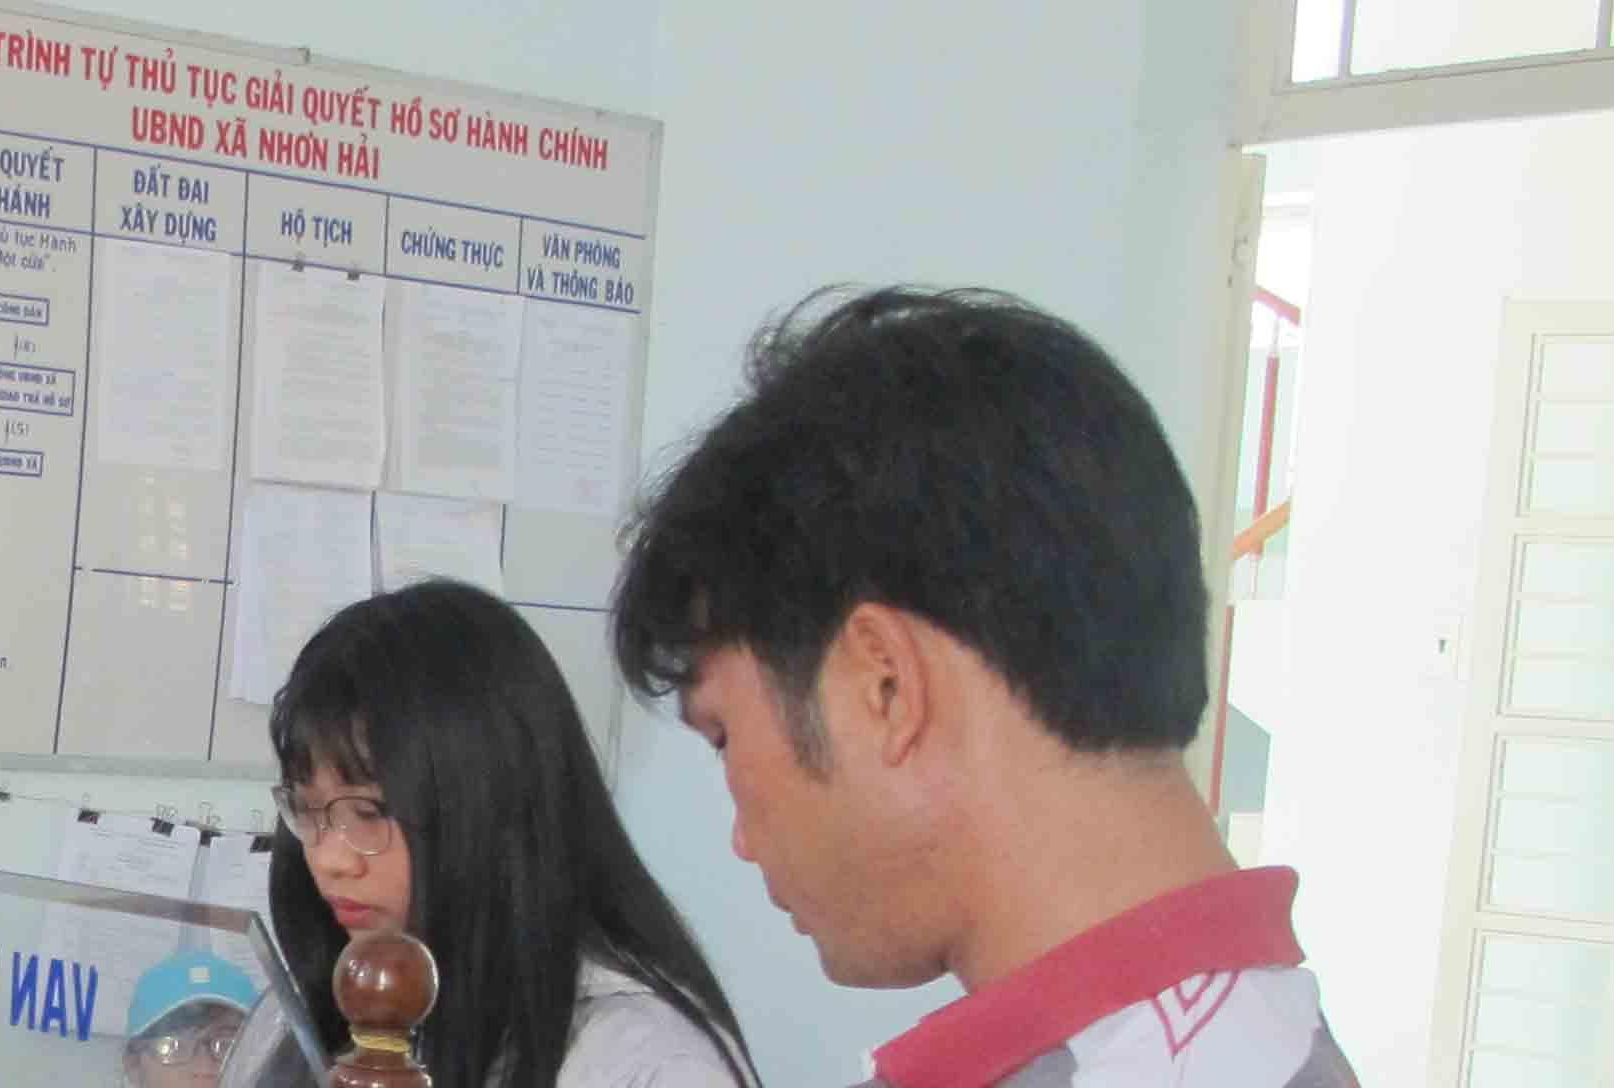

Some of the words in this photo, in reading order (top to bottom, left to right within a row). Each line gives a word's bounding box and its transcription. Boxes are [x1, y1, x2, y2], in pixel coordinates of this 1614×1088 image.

[81, 45, 119, 91] TỰ
[125, 48, 177, 94] THỦ
[187, 64, 236, 109] TỤC
[246, 69, 294, 115] GIẢI
[303, 84, 382, 129] QUYẾT
[429, 107, 461, 143] SƠ
[467, 110, 529, 156] HÀNH
[539, 127, 608, 170] CHÍNH
[0, 145, 65, 182] QUYẾT
[132, 106, 204, 150] UBND
[215, 117, 247, 158] XÃ
[259, 127, 329, 171] NHƠN
[338, 133, 379, 179] HẢI
[133, 163, 171, 199] ĐẤT
[178, 176, 210, 205] ĐAI
[119, 203, 160, 235] XÂY
[164, 212, 217, 246] DỰNG
[280, 209, 306, 242] HỘ
[313, 216, 353, 248] TỊCH
[401, 225, 456, 260] CHỨNG
[461, 238, 505, 270] THỰC
